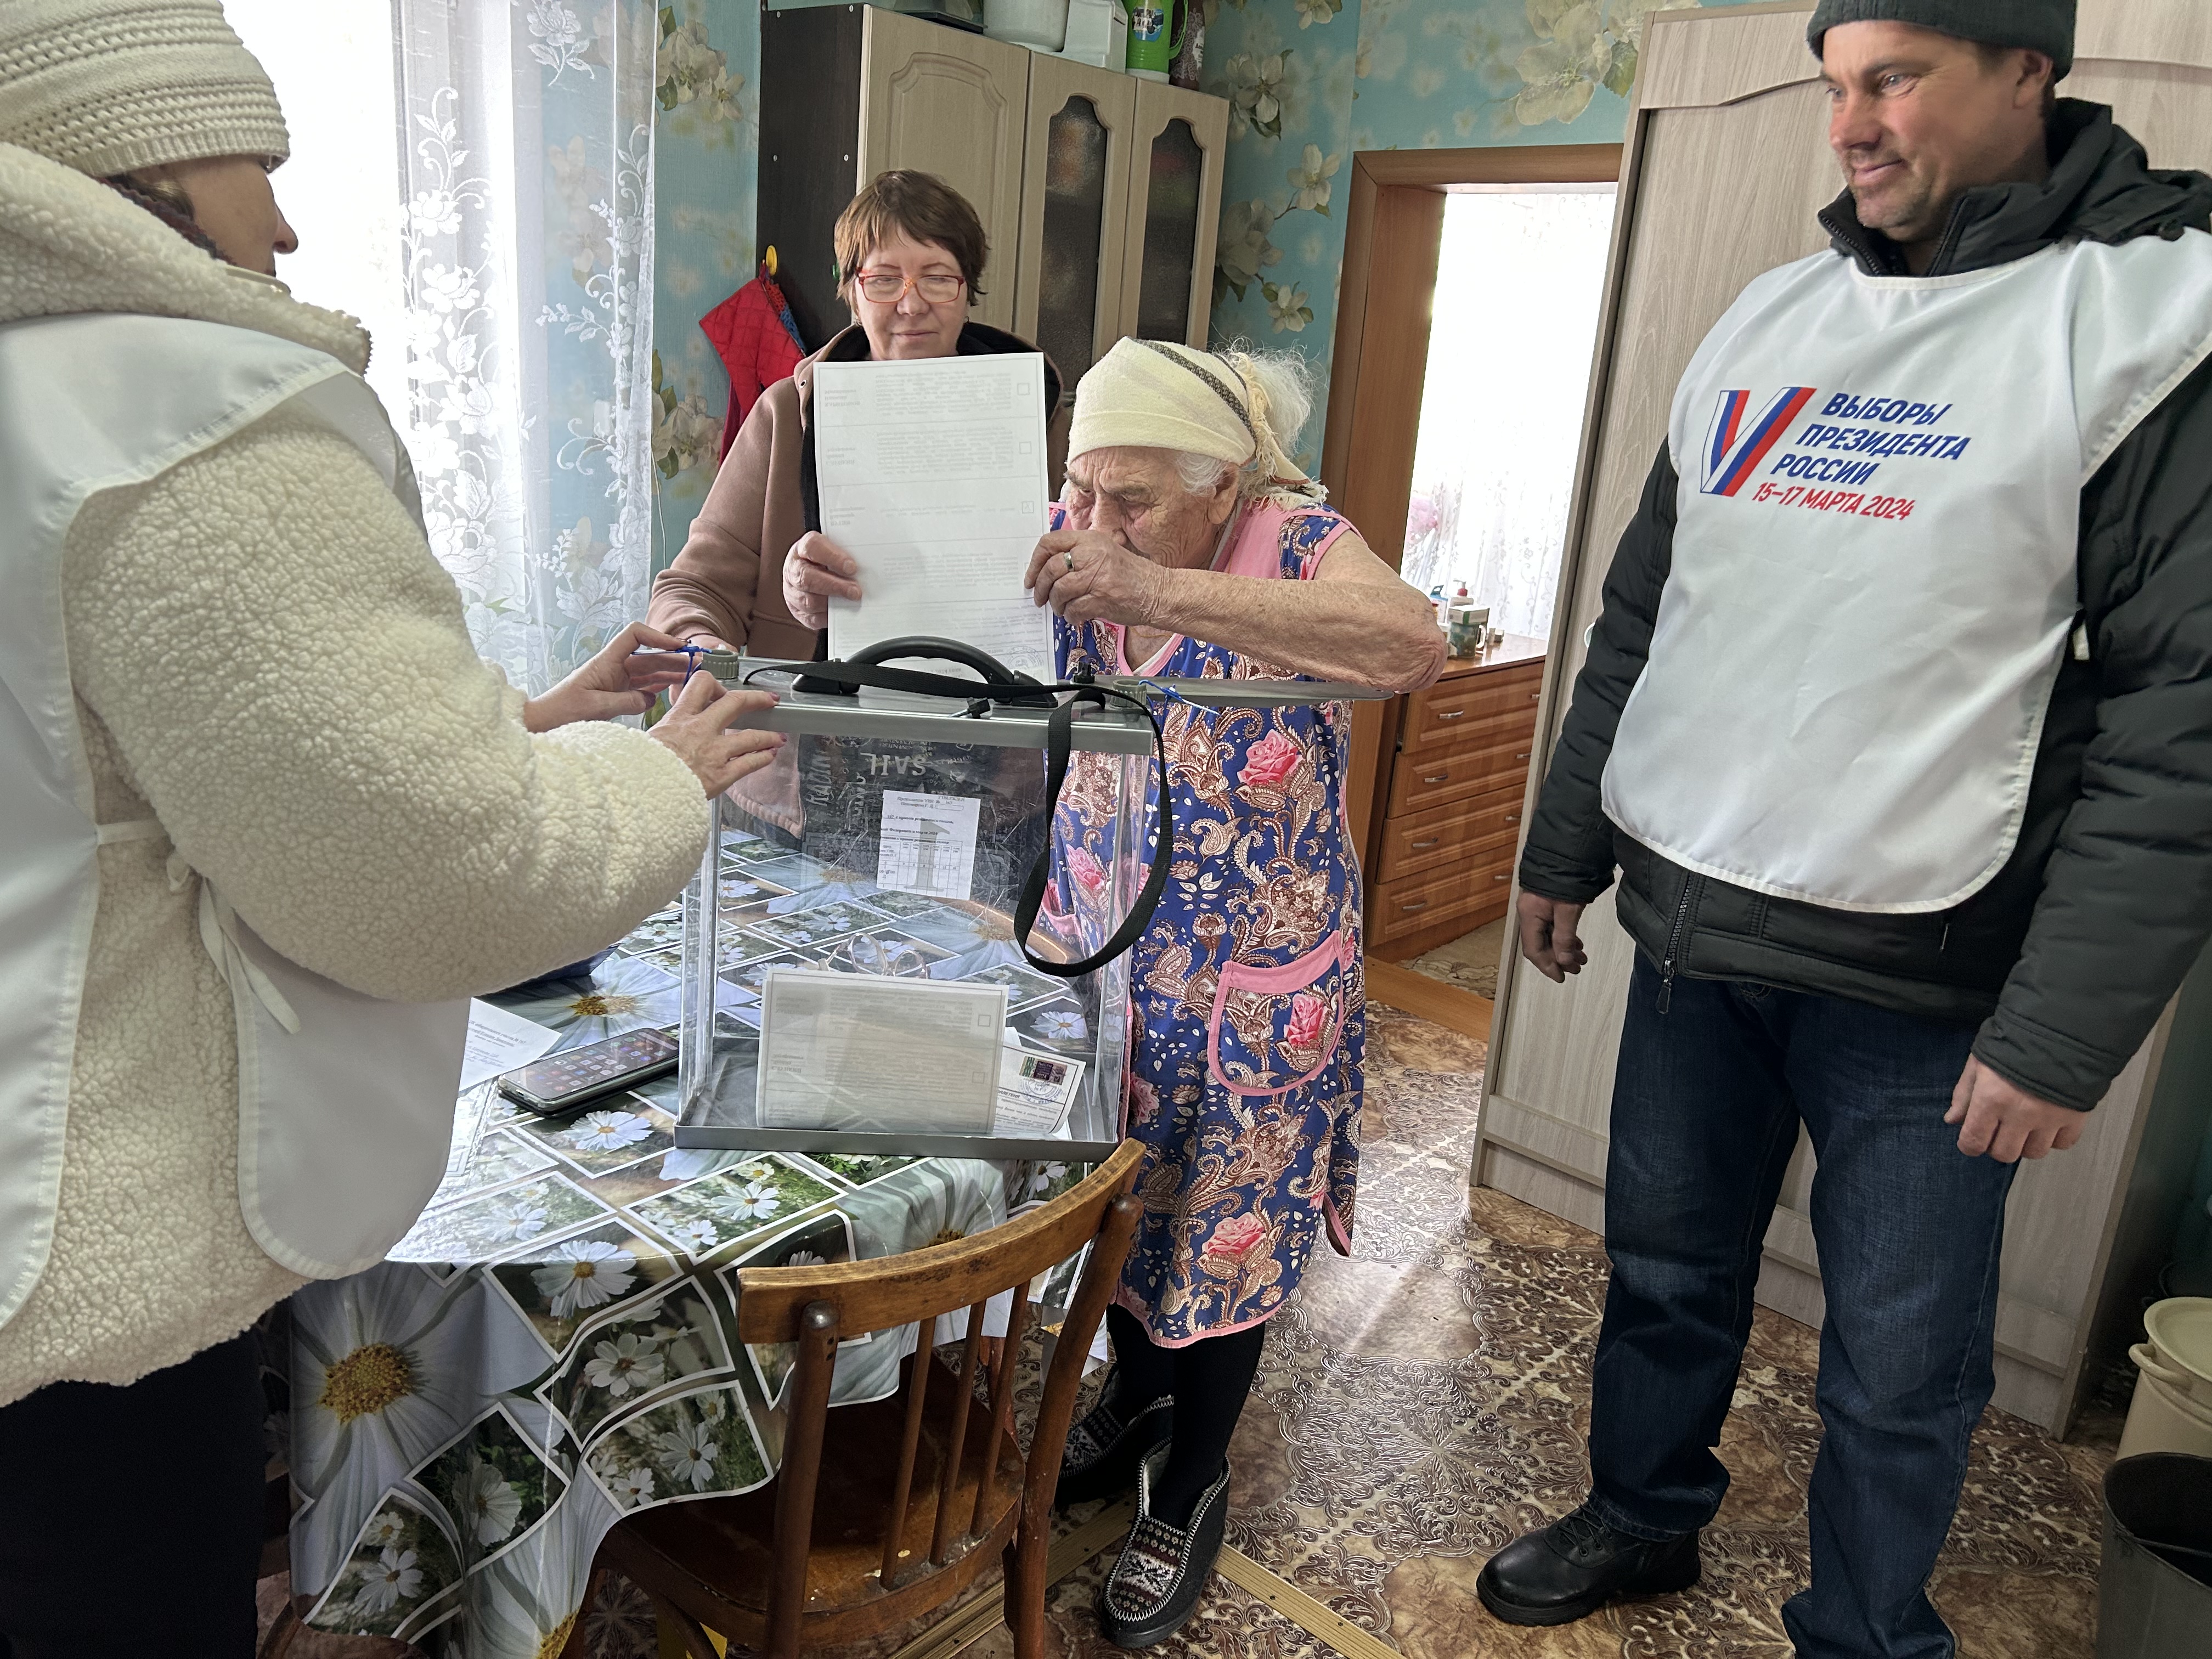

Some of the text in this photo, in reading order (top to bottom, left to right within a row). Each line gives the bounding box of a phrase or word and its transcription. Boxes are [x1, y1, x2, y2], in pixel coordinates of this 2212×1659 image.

[1820, 393, 1953, 426] ВЫБОРЫ
[1795, 424, 1972, 460] ПРЕЗИДЕНТА
[1769, 453, 1880, 484] РОССИИ
[1802, 488, 1863, 514] МАРТА
[1859, 495, 1916, 521] 2024
